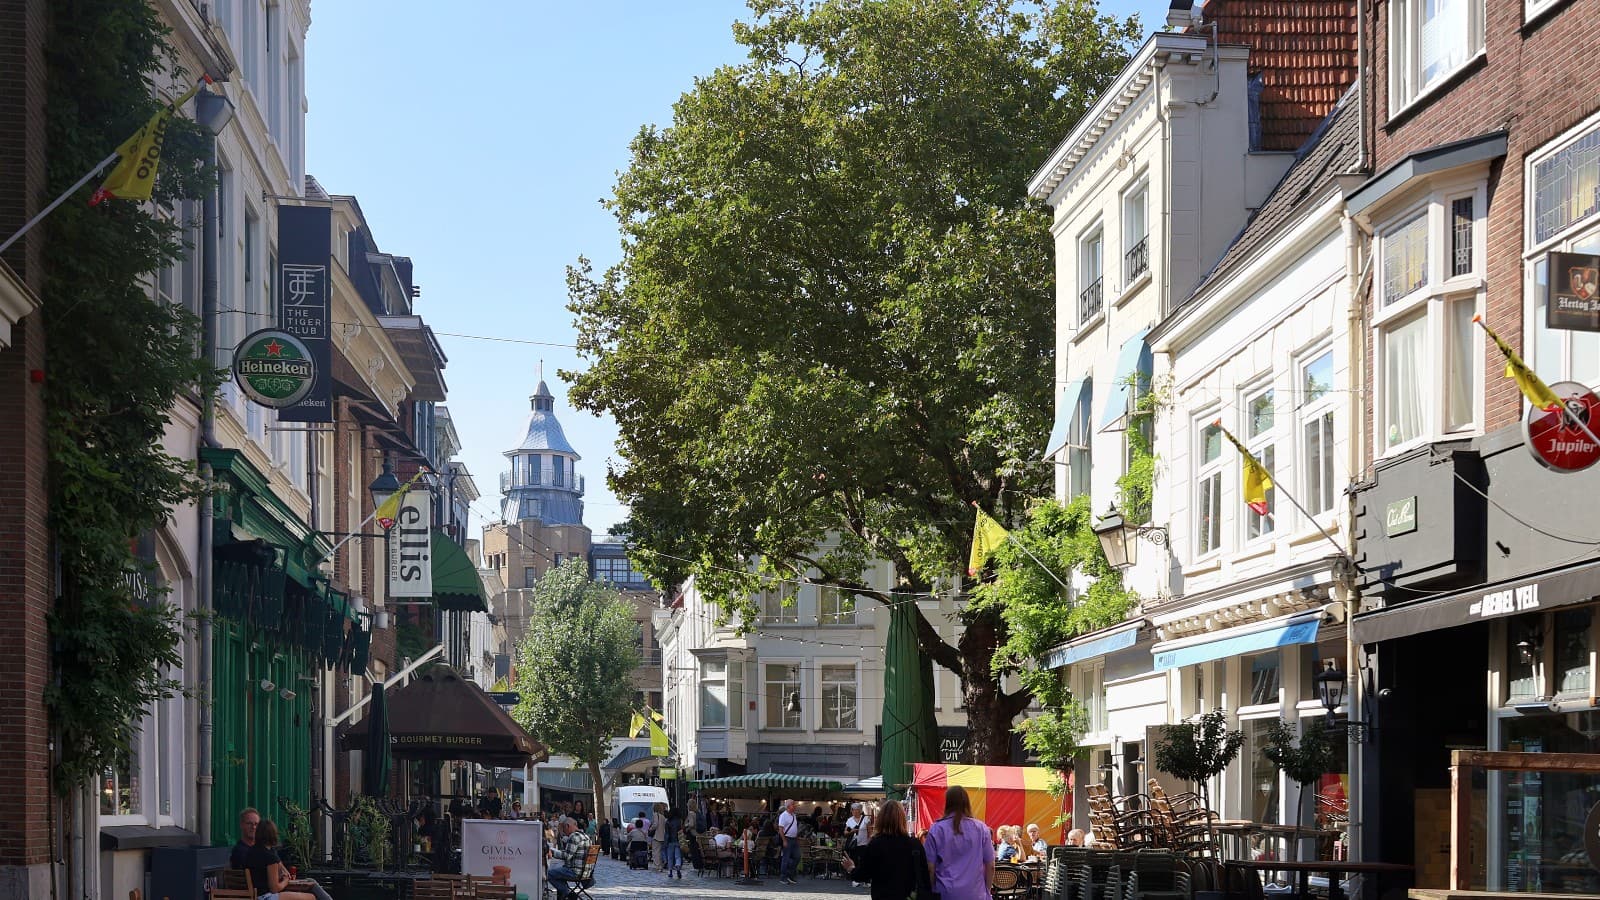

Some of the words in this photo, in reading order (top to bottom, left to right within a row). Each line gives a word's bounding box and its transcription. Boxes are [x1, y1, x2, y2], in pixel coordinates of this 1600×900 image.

[1558, 297, 1589, 311] Hertog
[287, 309, 309, 317] THE
[287, 317, 321, 326] TIGER
[287, 326, 317, 335] CLUB
[240, 361, 309, 376] Heineken
[1545, 439, 1598, 455] Jupiler
[400, 505, 429, 582] ellis
[1515, 583, 1540, 611] YELL
[400, 735, 443, 744] GOURMET
[446, 735, 482, 745] BURGER
[481, 845, 523, 857] GIVISA
